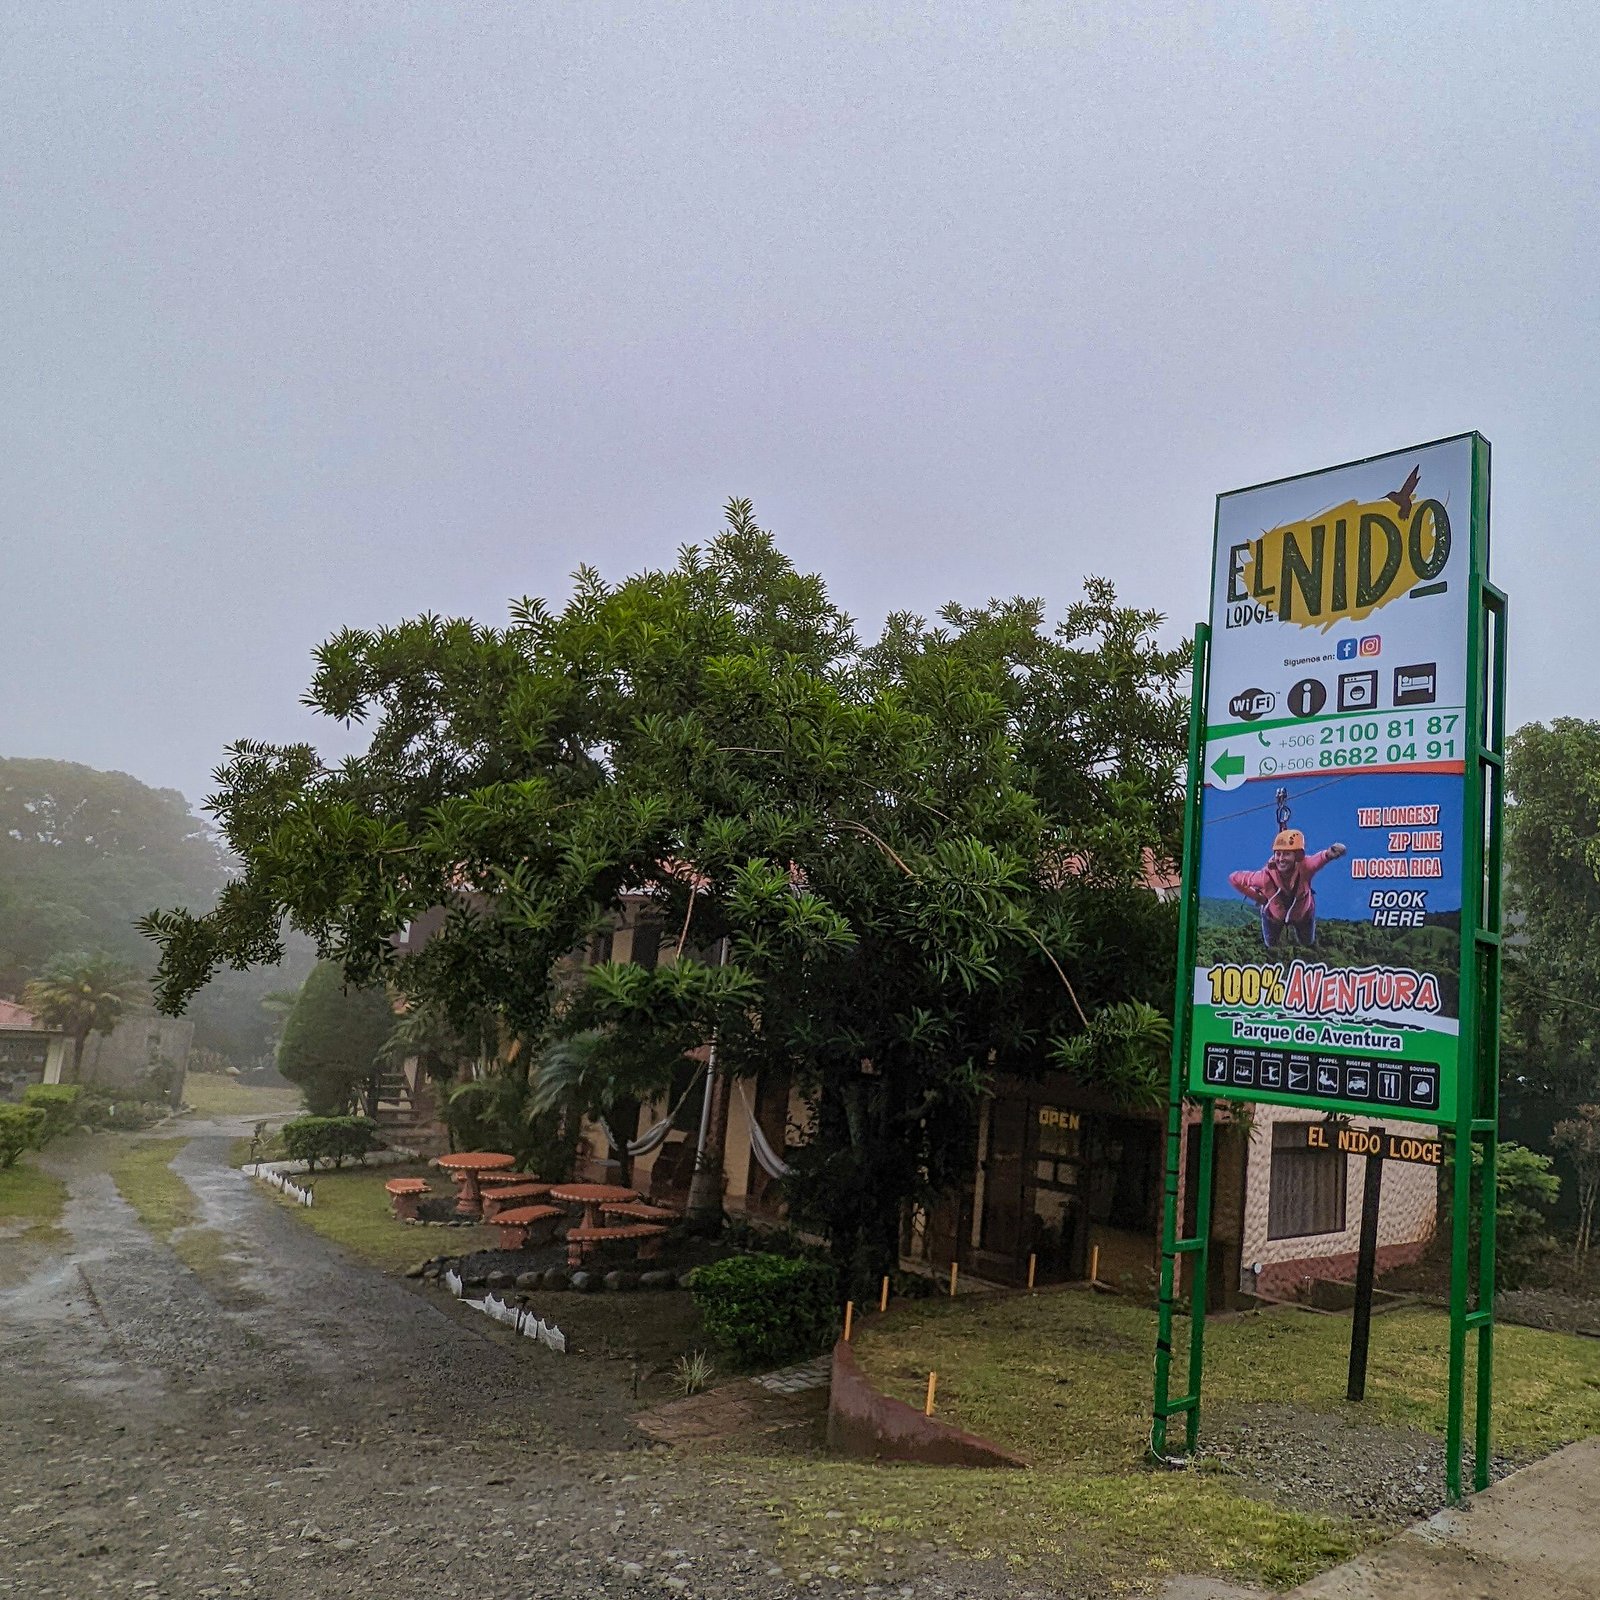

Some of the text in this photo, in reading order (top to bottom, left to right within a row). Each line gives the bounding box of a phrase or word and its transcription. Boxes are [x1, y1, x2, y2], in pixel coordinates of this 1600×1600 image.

[1227, 499, 1451, 622] EL NIDO
[1226, 600, 1274, 629] LODGE
[1279, 714, 1459, 749] +506 2100 81 87
[1279, 739, 1455, 771] +506 8682 04 91
[1358, 804, 1440, 827] THE LONGEST
[1388, 830, 1442, 851] ZIP LINE
[1352, 857, 1442, 878] IN COSTA RICA
[1370, 891, 1427, 908] BOOK
[1373, 911, 1425, 927] HERE
[1208, 960, 1441, 1017] 100% AVENTURA
[1233, 1020, 1404, 1051] Parque de Aventura
[1039, 1108, 1079, 1130] OPEN
[1308, 1126, 1442, 1163] EL NIDO LODGE
